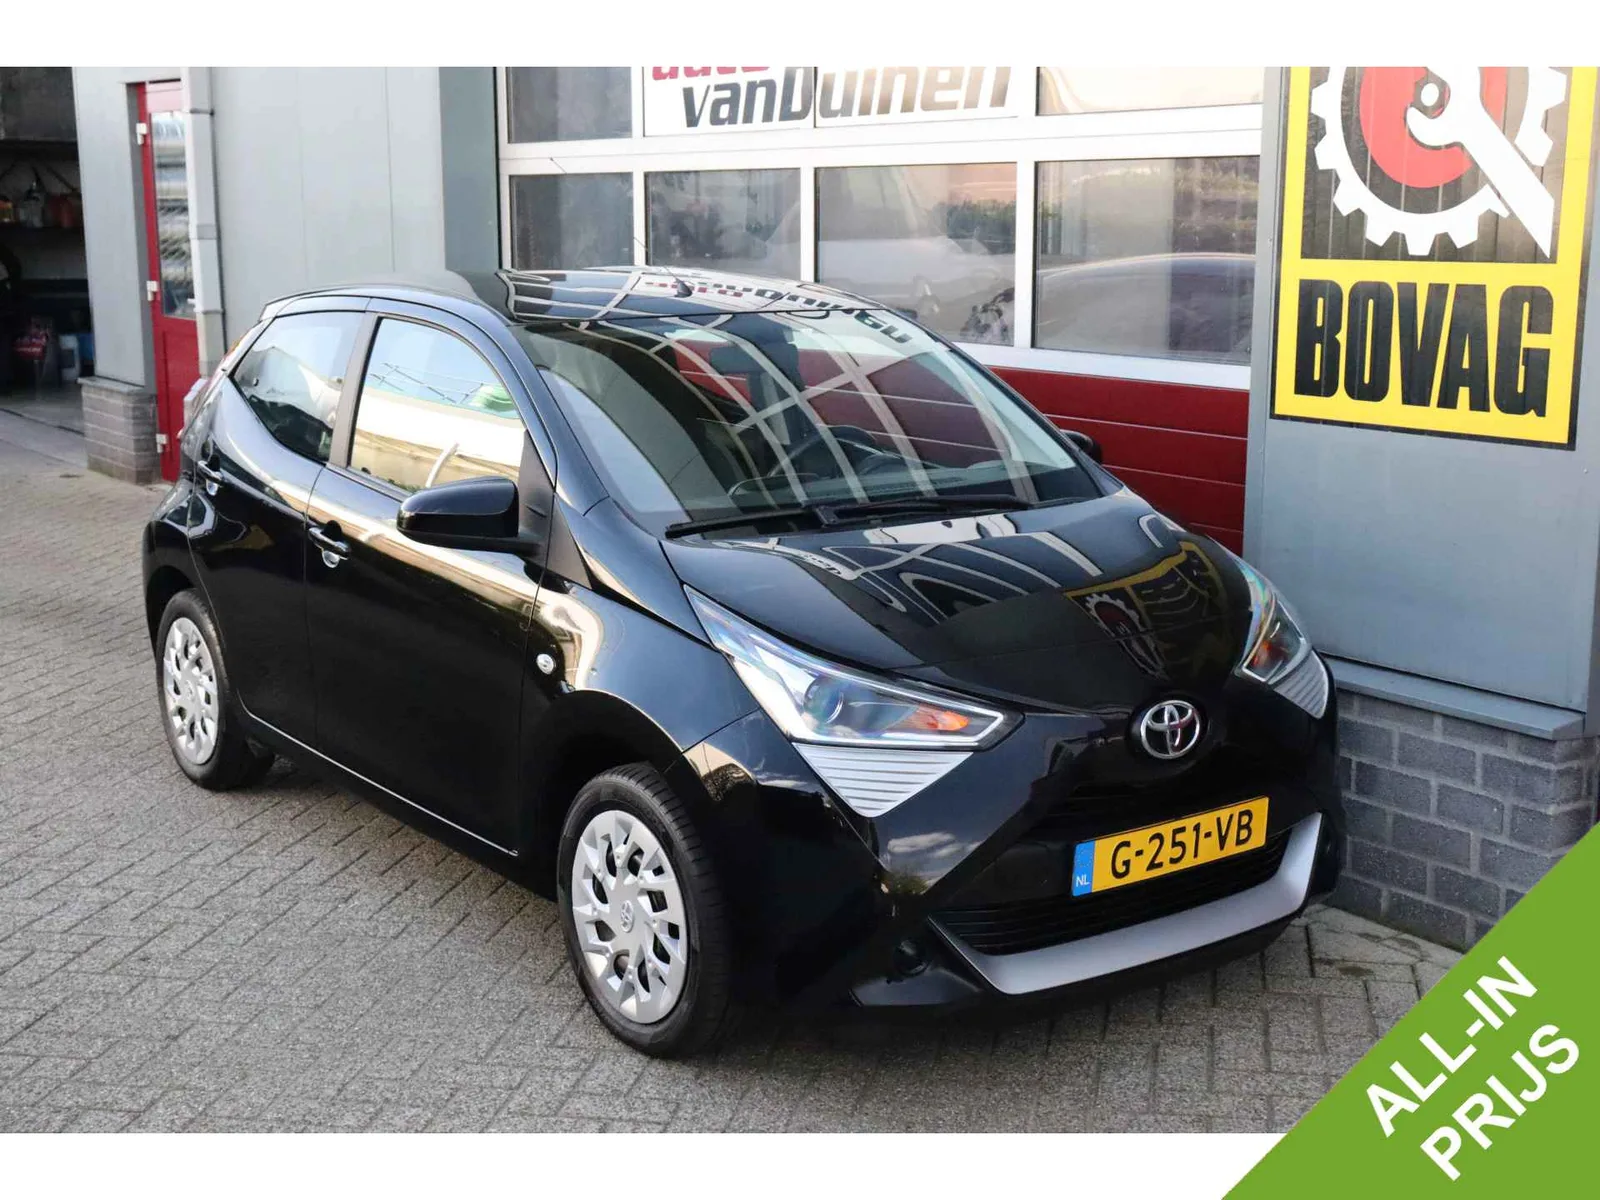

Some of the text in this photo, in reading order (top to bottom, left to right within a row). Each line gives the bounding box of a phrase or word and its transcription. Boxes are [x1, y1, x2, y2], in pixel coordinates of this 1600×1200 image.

[1294, 278, 1554, 418] BOVAG
[1075, 809, 1253, 887] NL G-251-VB
